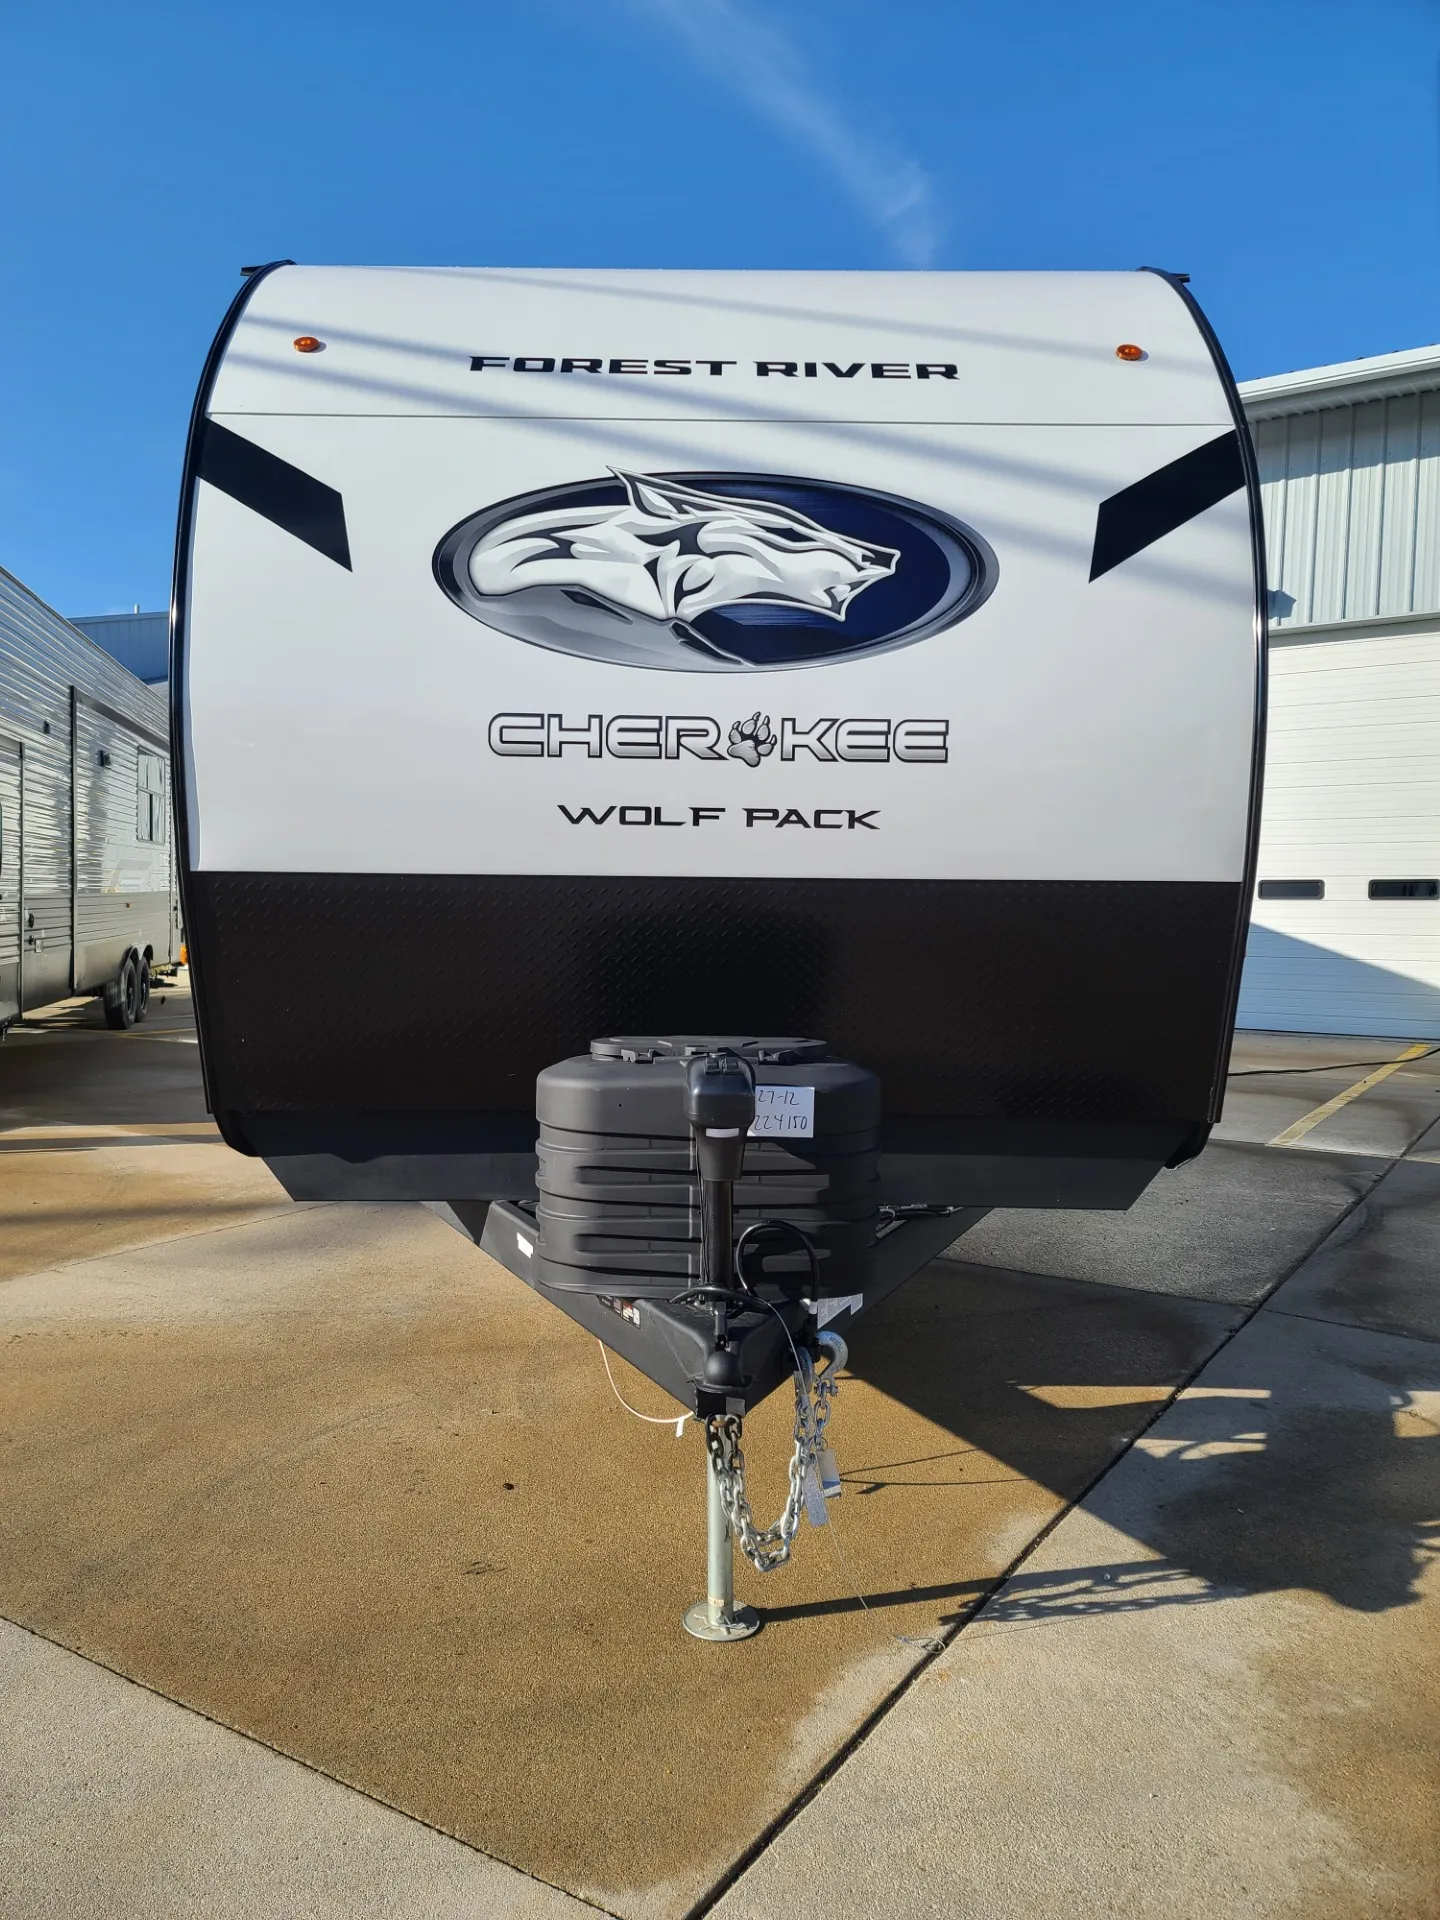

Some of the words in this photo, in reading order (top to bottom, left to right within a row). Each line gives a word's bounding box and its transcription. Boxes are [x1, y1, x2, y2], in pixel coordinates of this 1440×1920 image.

[469, 355, 737, 376] FOREST
[755, 361, 960, 380] RIVER
[557, 804, 727, 827] WOLF
[742, 807, 881, 830] PACK
[758, 1089, 800, 1106] 27-12
